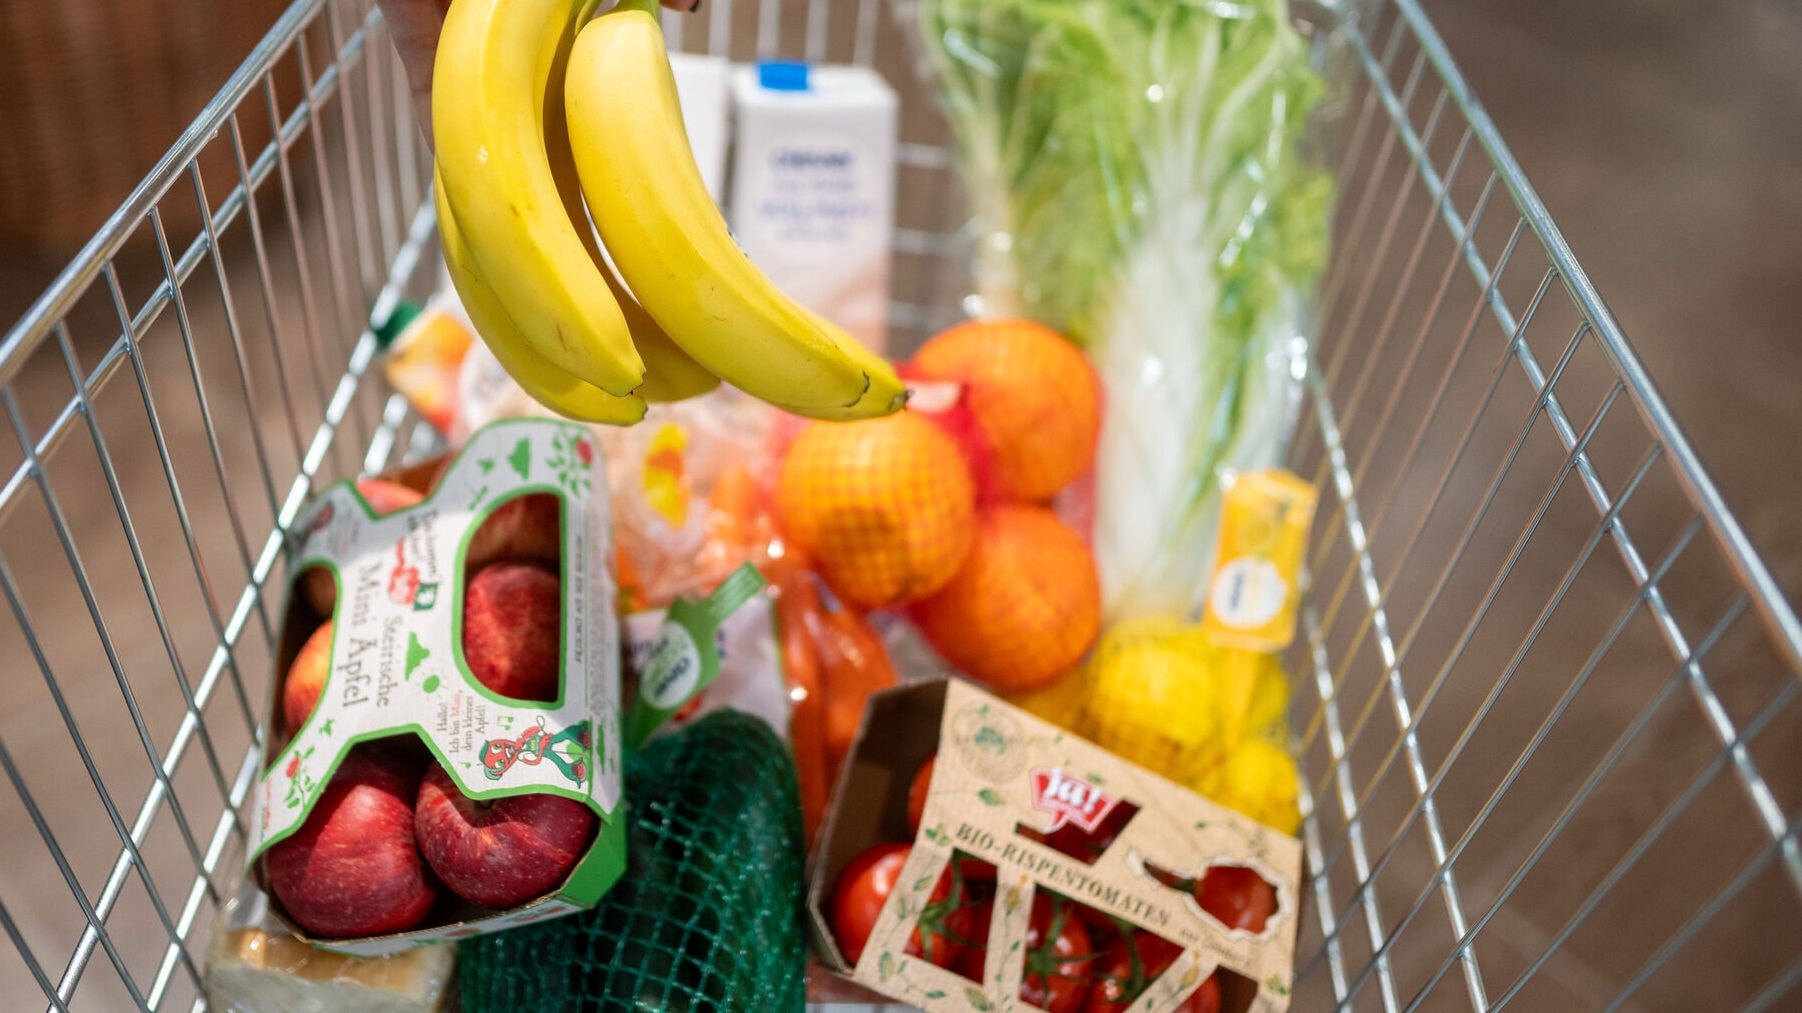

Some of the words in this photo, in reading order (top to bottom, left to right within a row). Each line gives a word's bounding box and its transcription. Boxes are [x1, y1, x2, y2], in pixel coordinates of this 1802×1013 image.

[352, 561, 382, 626] Mini
[338, 637, 378, 708] Äpfel
[377, 616, 403, 708] Steirische
[448, 738, 460, 753] Ich
[449, 720, 460, 736] bin
[461, 731, 473, 752] dein
[955, 822, 1171, 927] BIO-RISPENTOMATEN
